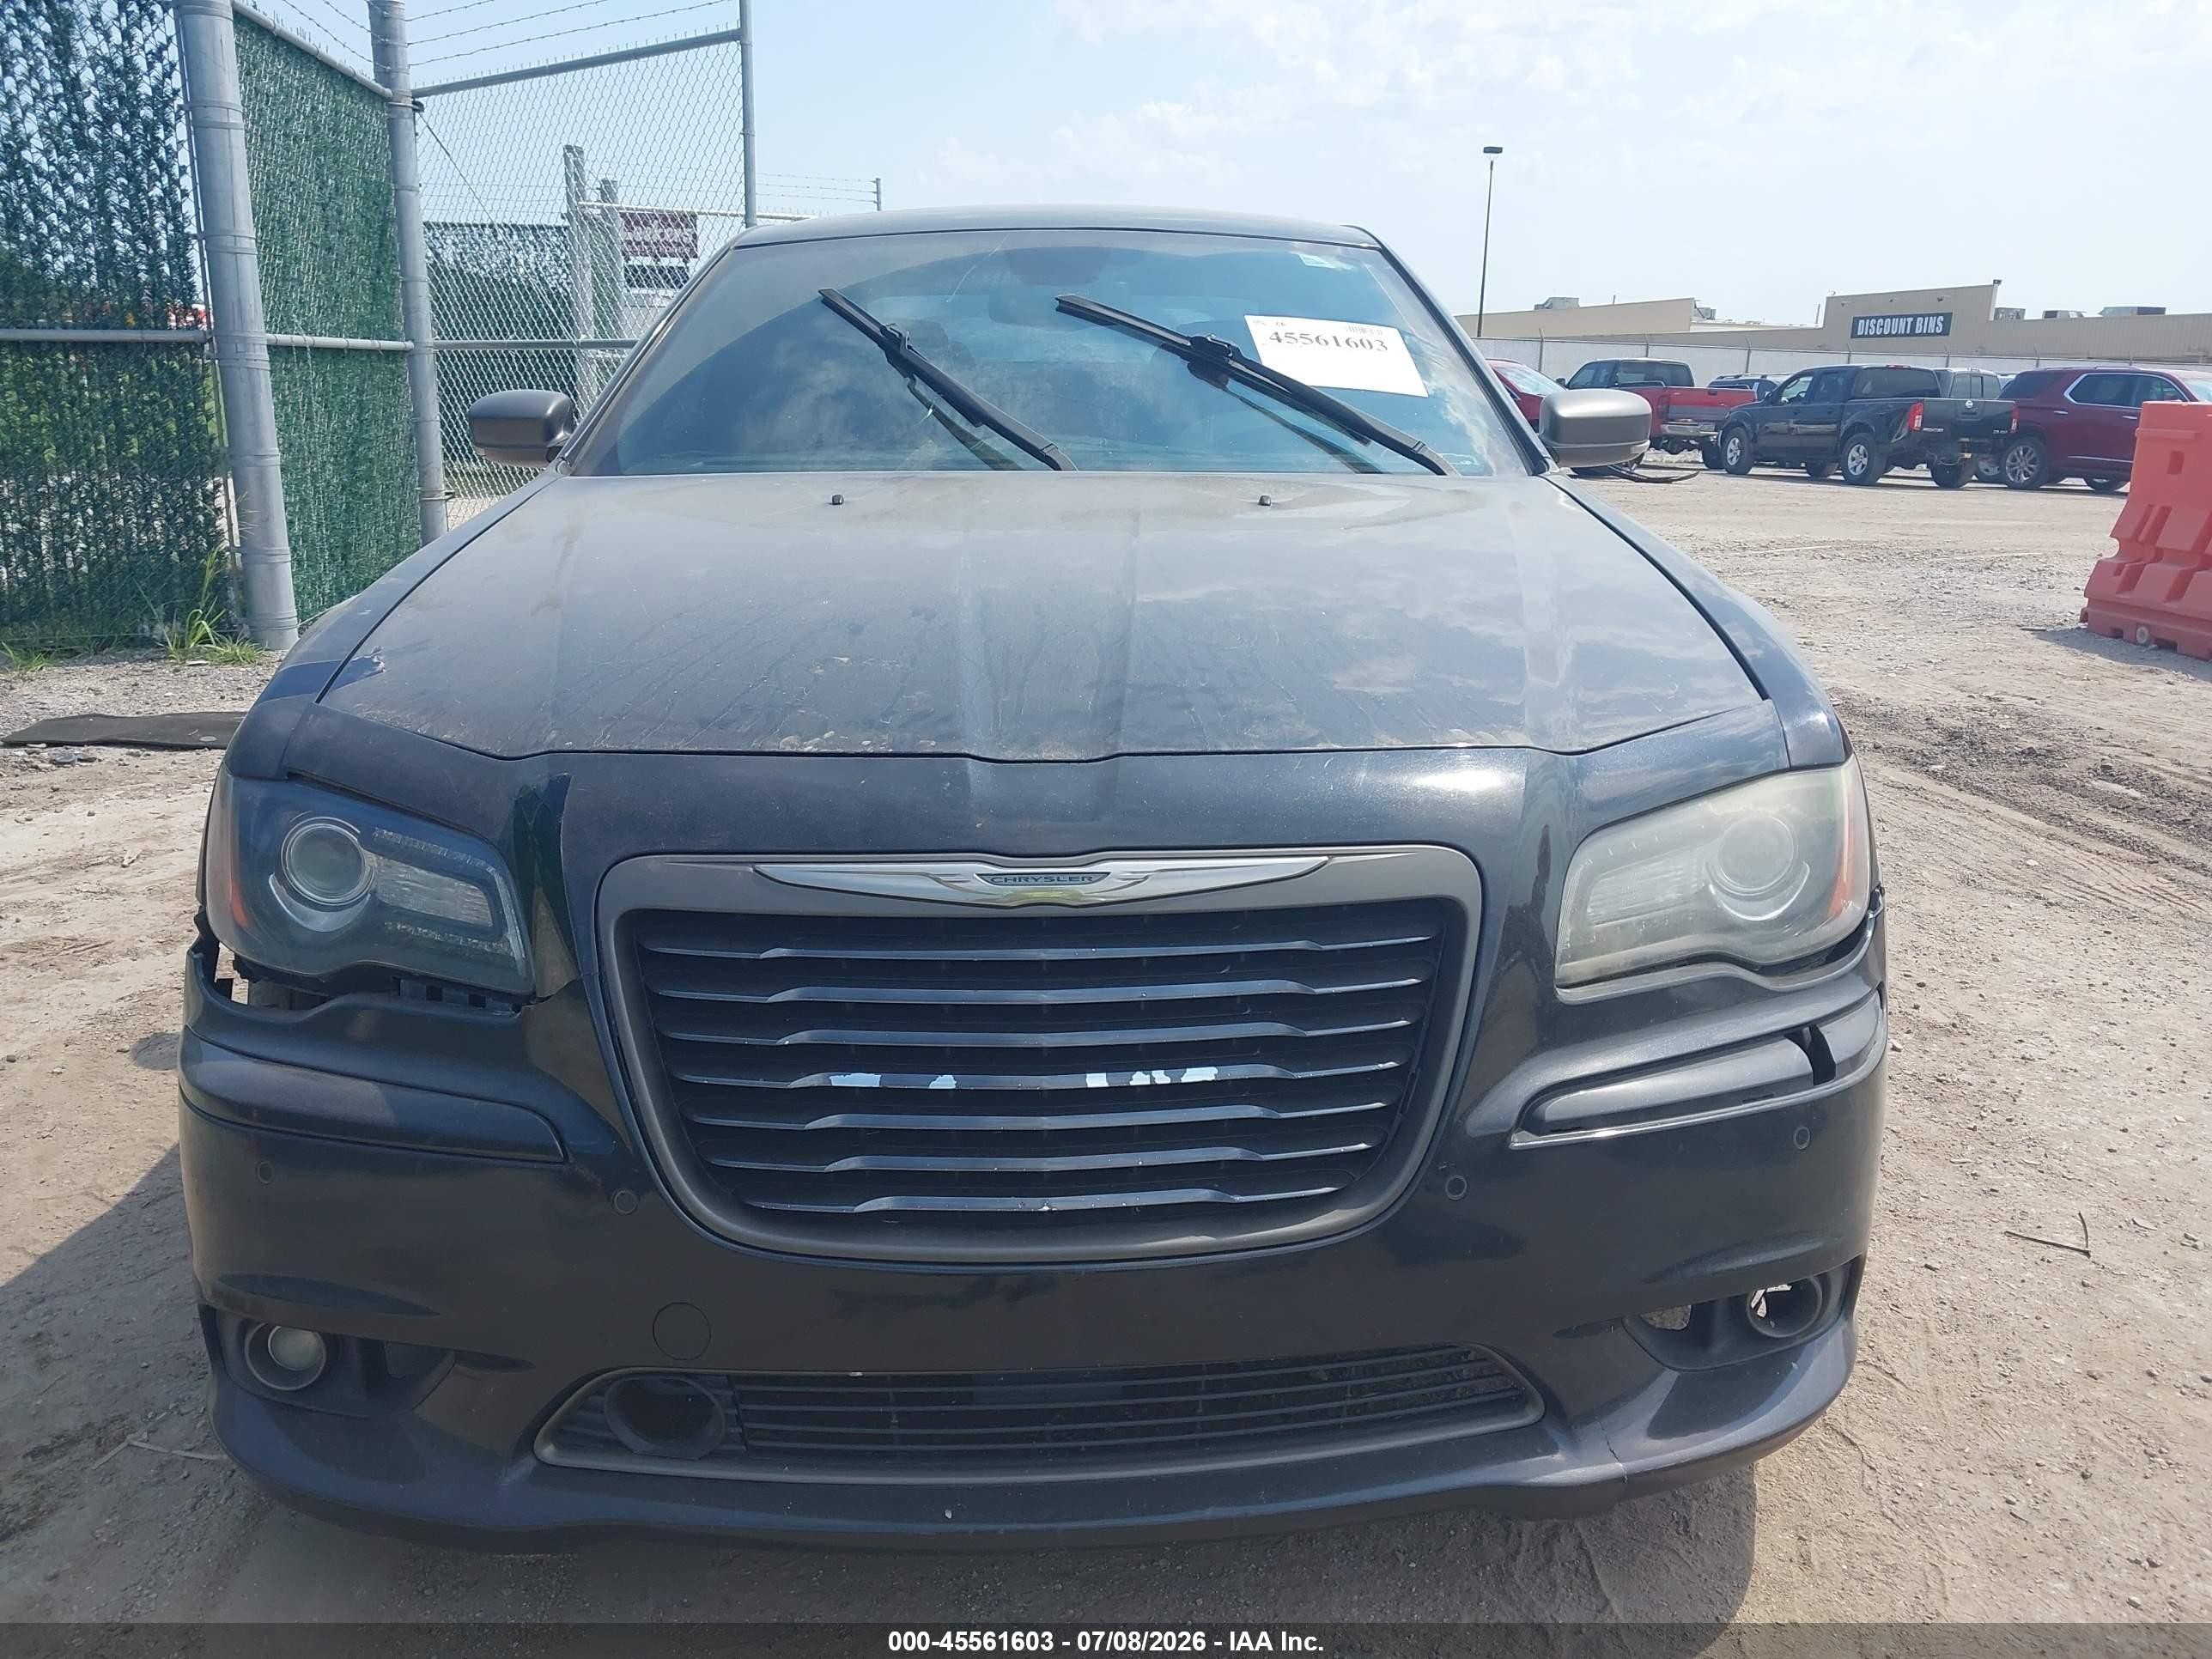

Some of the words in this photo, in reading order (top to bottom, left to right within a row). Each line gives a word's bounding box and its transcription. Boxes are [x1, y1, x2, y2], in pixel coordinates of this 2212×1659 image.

[1856, 317, 1913, 336] DISCOUNT
[1915, 315, 1944, 334] BINS
[1268, 331, 1389, 352] 45561603
[990, 875, 1093, 884] CHRYSLER
